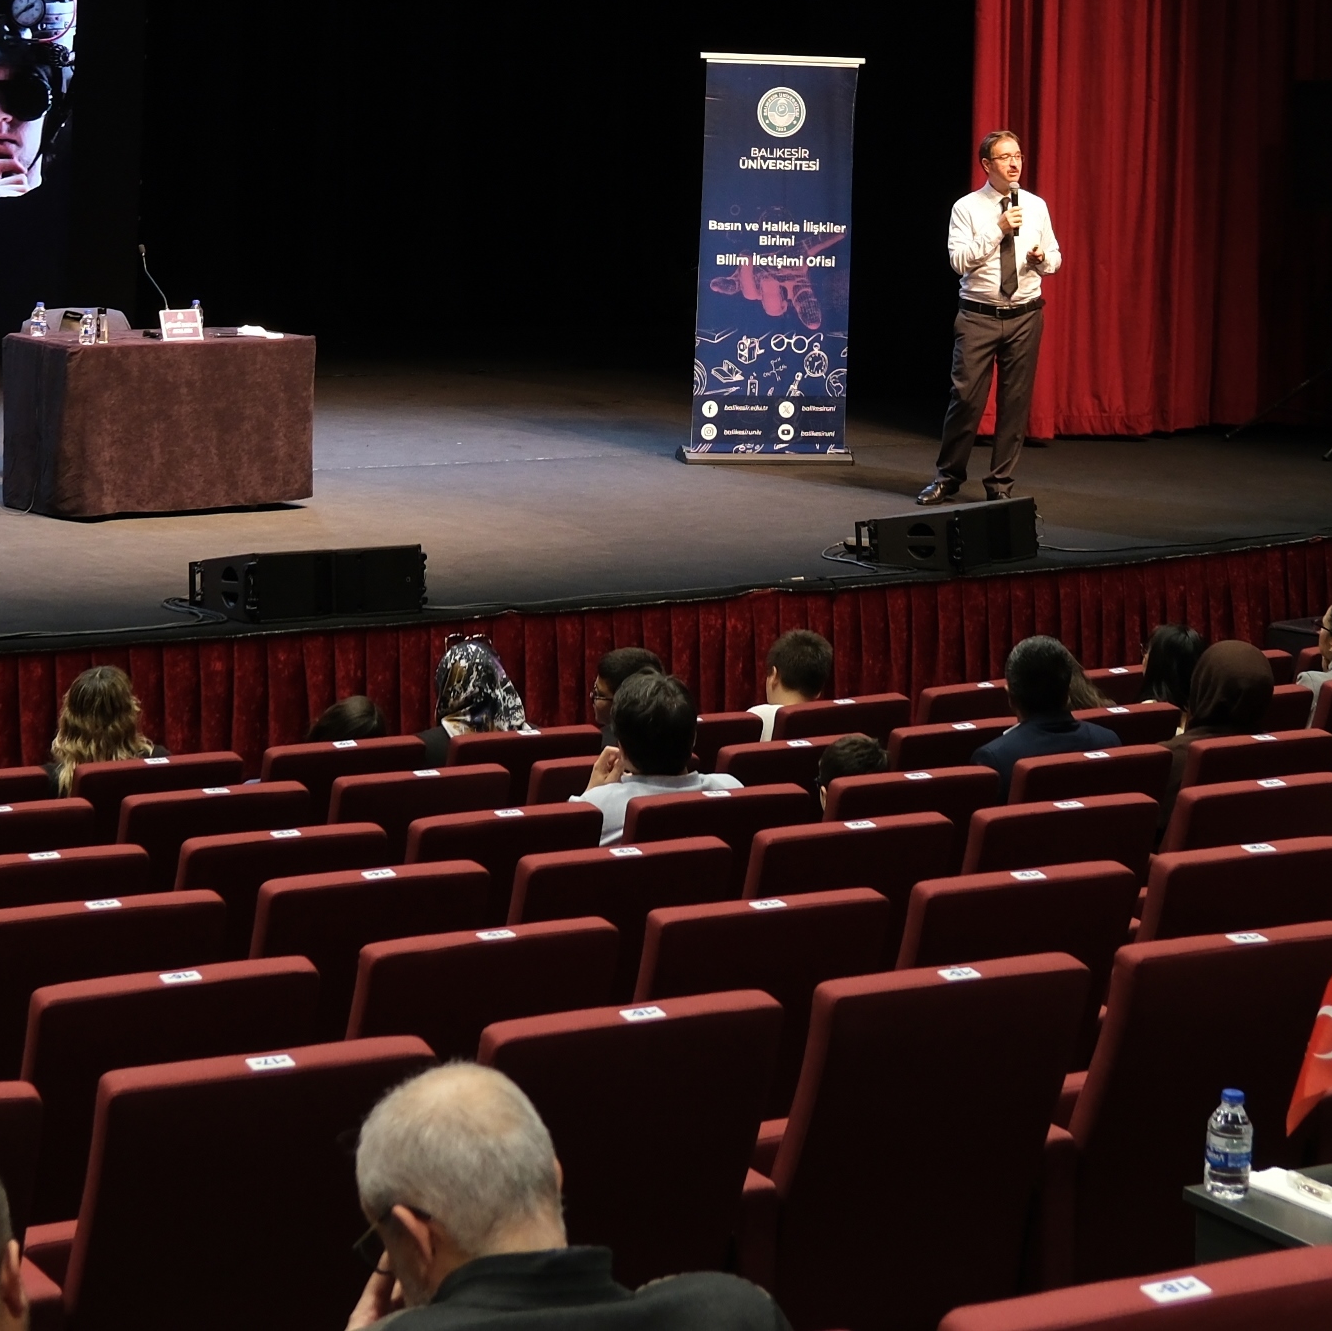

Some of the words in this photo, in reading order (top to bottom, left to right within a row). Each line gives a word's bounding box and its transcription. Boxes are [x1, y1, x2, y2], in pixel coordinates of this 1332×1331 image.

[750, 146, 810, 159] BALIKESİR
[739, 156, 820, 171] ÜNİVERSİTESİ
[708, 219, 742, 231] Basın
[744, 221, 759, 231] ve
[762, 220, 800, 233] Halkla
[803, 219, 847, 235] İlişkiler
[758, 234, 795, 246] Birimi
[716, 253, 749, 266] Bilim
[752, 252, 804, 269] İletişimi
[806, 255, 836, 268] Ofisi
[262, 1057, 280, 1066] 17
[1160, 1281, 1191, 1294] 18
